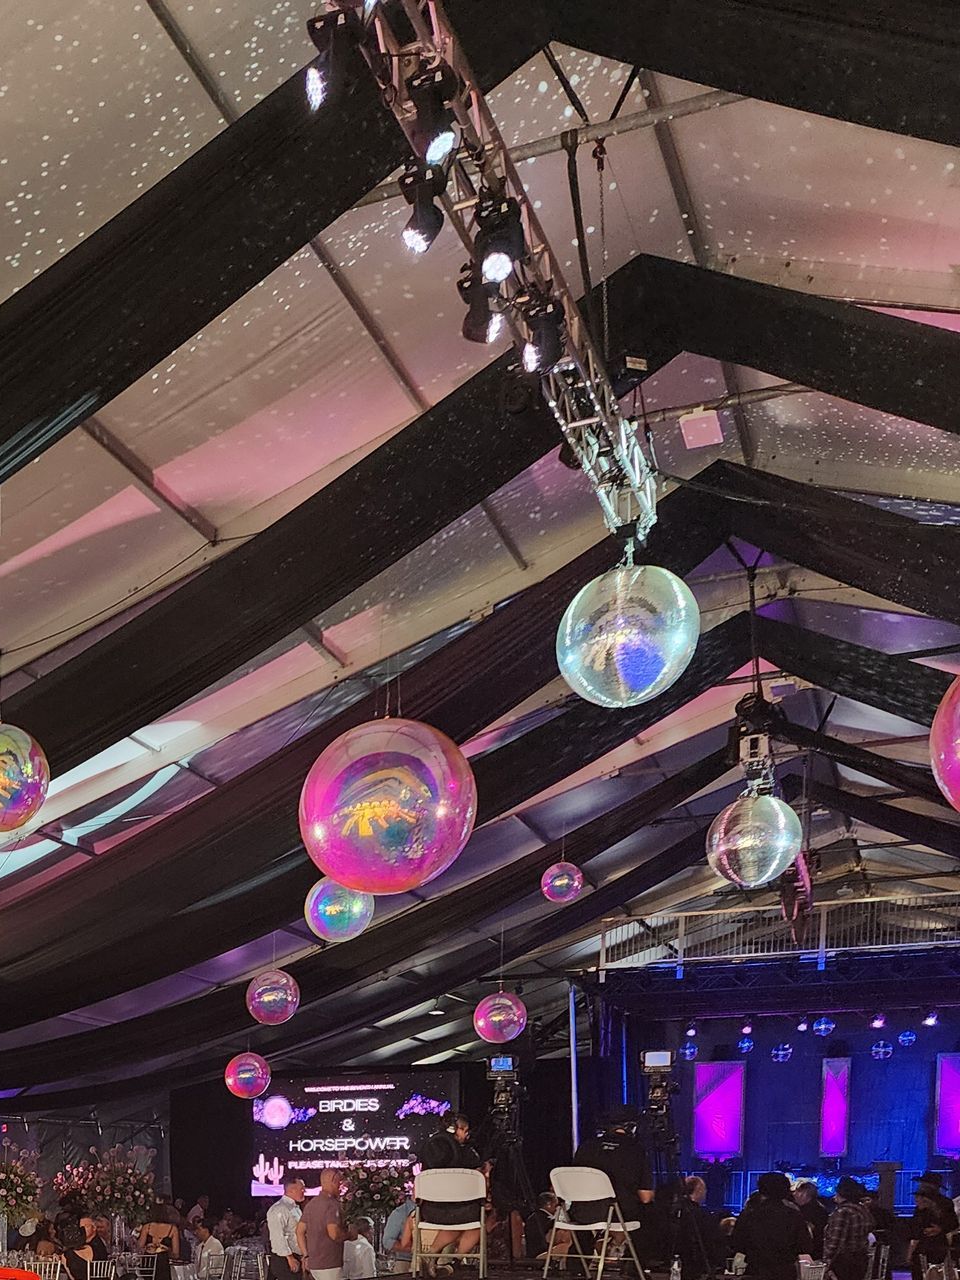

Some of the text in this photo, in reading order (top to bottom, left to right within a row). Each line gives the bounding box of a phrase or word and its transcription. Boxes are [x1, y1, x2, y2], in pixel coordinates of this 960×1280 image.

[319, 1098, 380, 1112] BIRDIES
[342, 1118, 355, 1131] &
[289, 1137, 411, 1152] HORSEPOWER
[288, 1160, 324, 1169] PLEASE
[324, 1160, 348, 1168] TAKE
